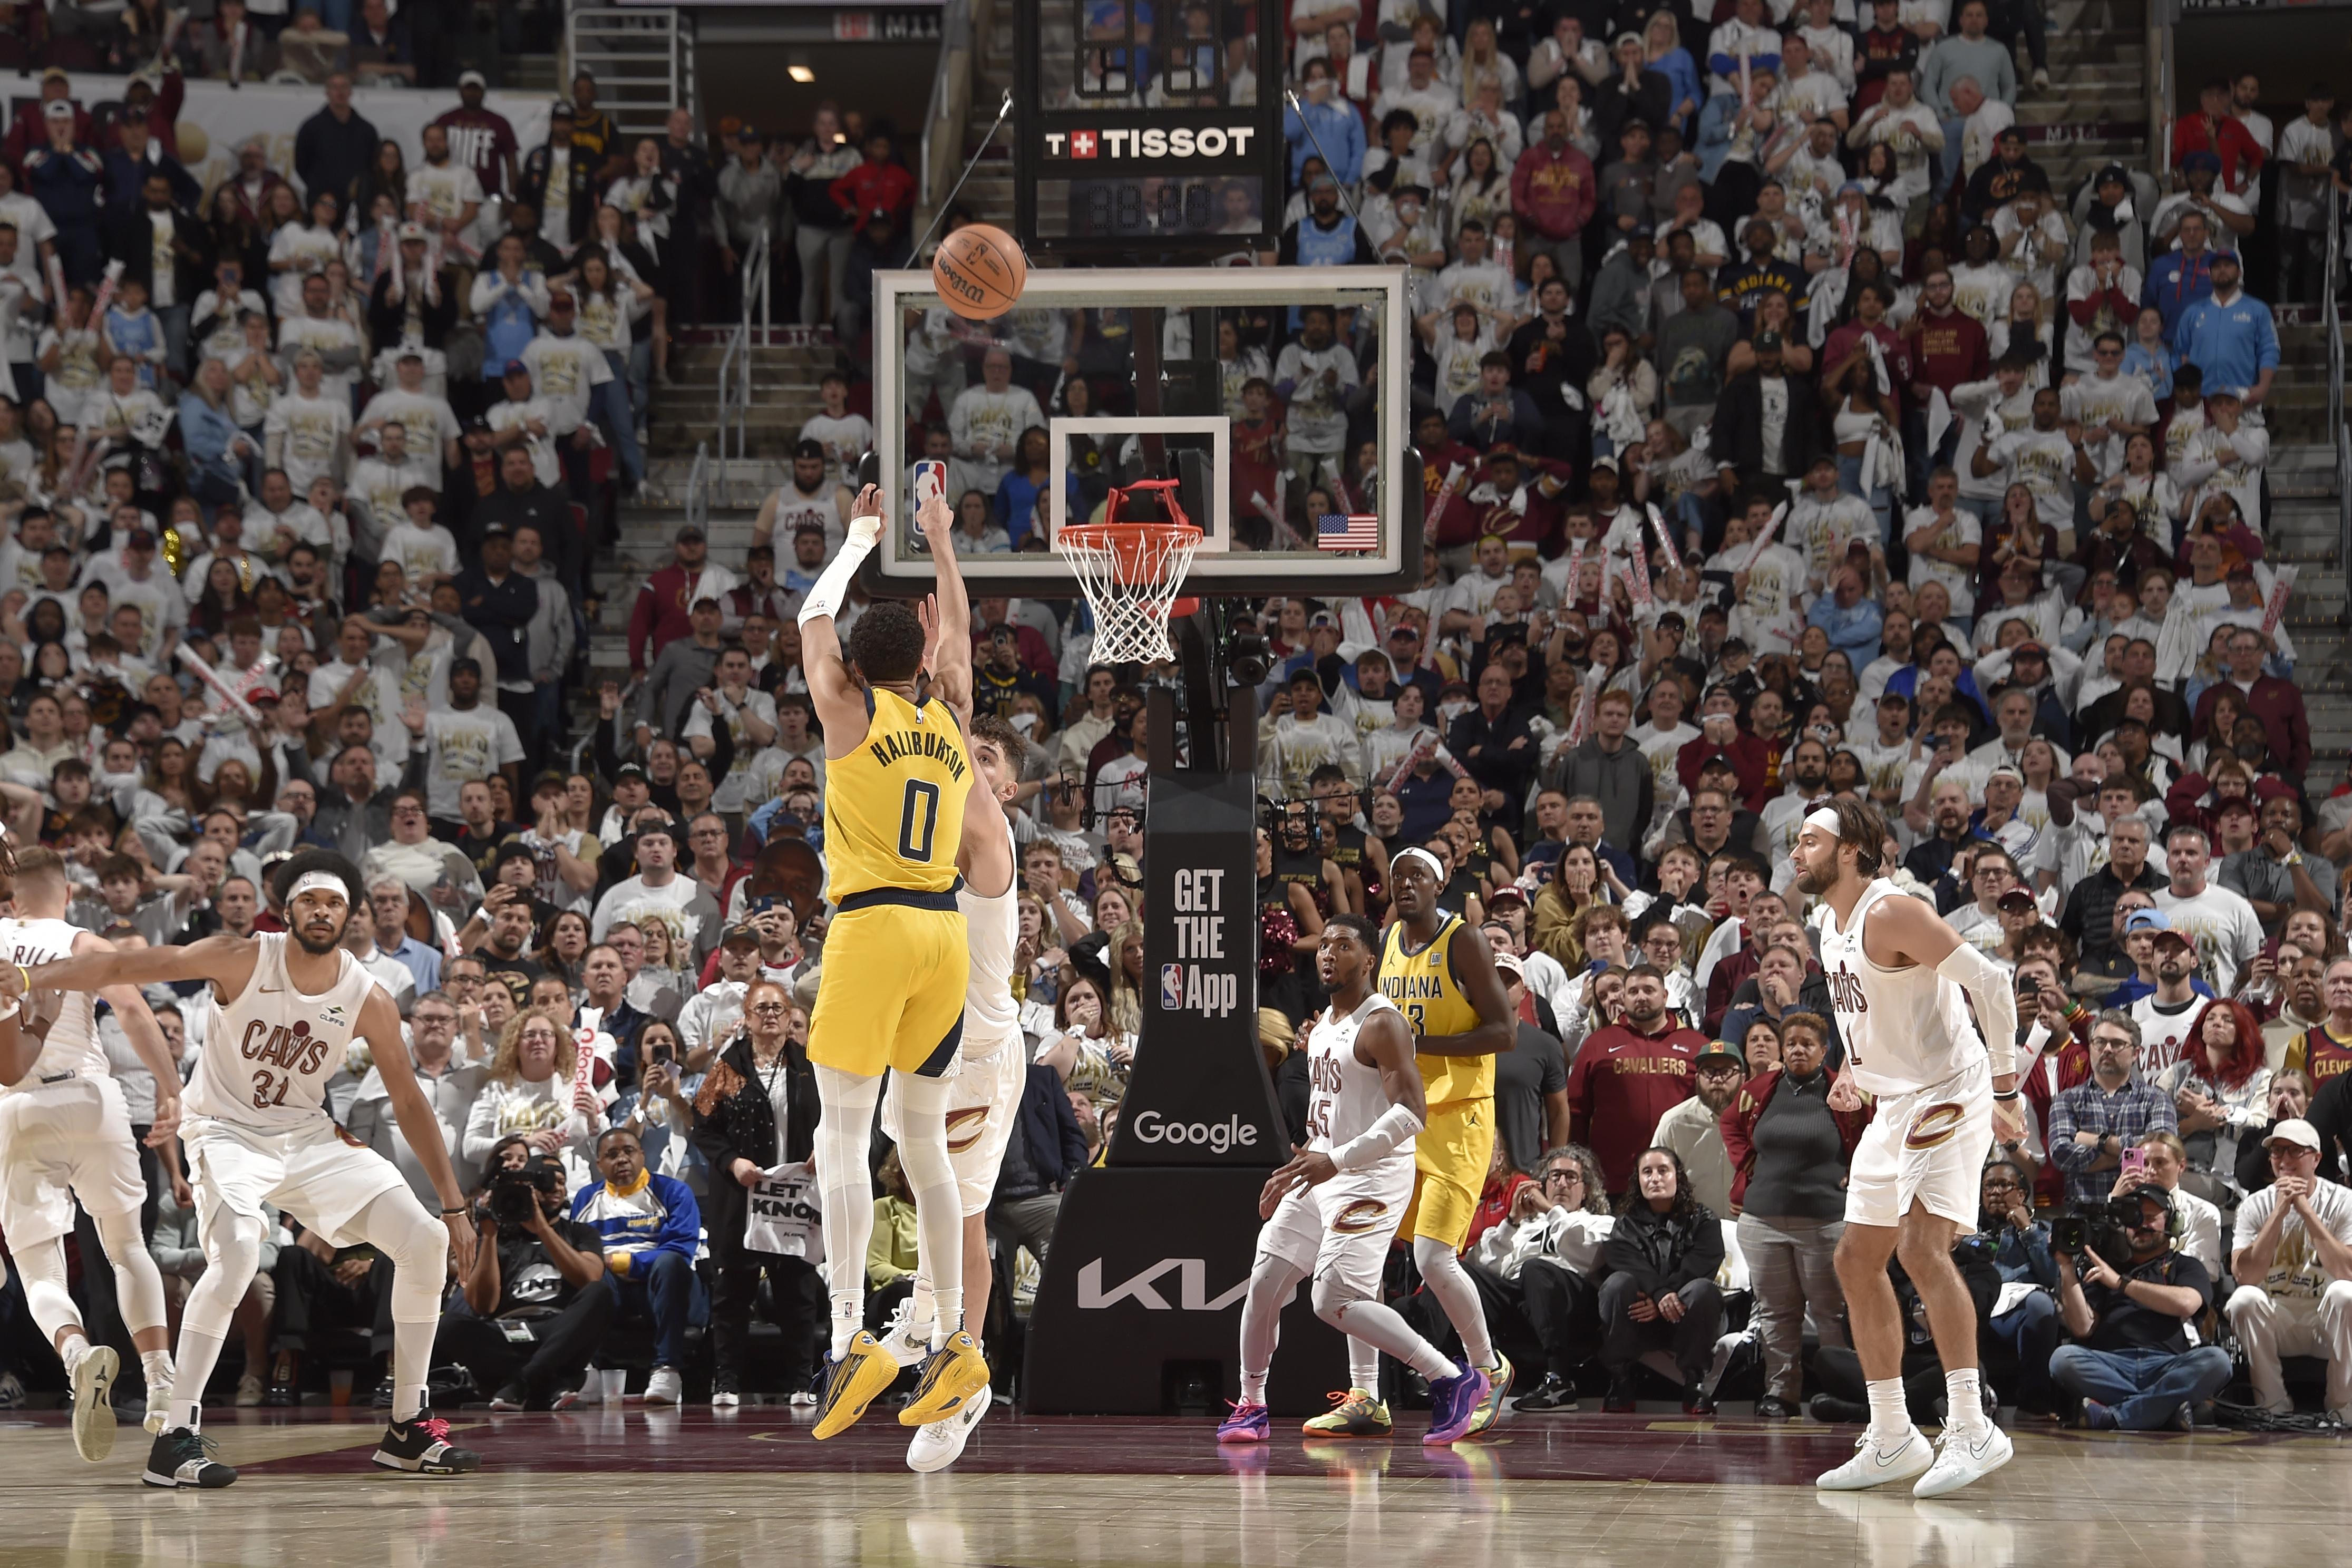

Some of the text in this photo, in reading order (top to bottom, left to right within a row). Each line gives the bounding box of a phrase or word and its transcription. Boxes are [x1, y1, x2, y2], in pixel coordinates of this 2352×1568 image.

[1102, 127, 1255, 158] TISSOT
[938, 256, 985, 304] Wilson
[870, 731, 966, 783] HALIBURTON
[898, 778, 941, 863] 0
[1174, 869, 1224, 912] GET
[1173, 916, 1225, 959] THE
[1185, 965, 1237, 1018] App
[320, 1014, 345, 1027] CLIFFS
[241, 1019, 329, 1075] CAVS
[1846, 1022, 1862, 1066] 1
[2137, 1044, 2182, 1073] CAV
[1613, 1056, 1687, 1077] CAVALIERS
[251, 1069, 289, 1109] 31
[1134, 1110, 1258, 1154] Google
[754, 1182, 803, 1198] LET
